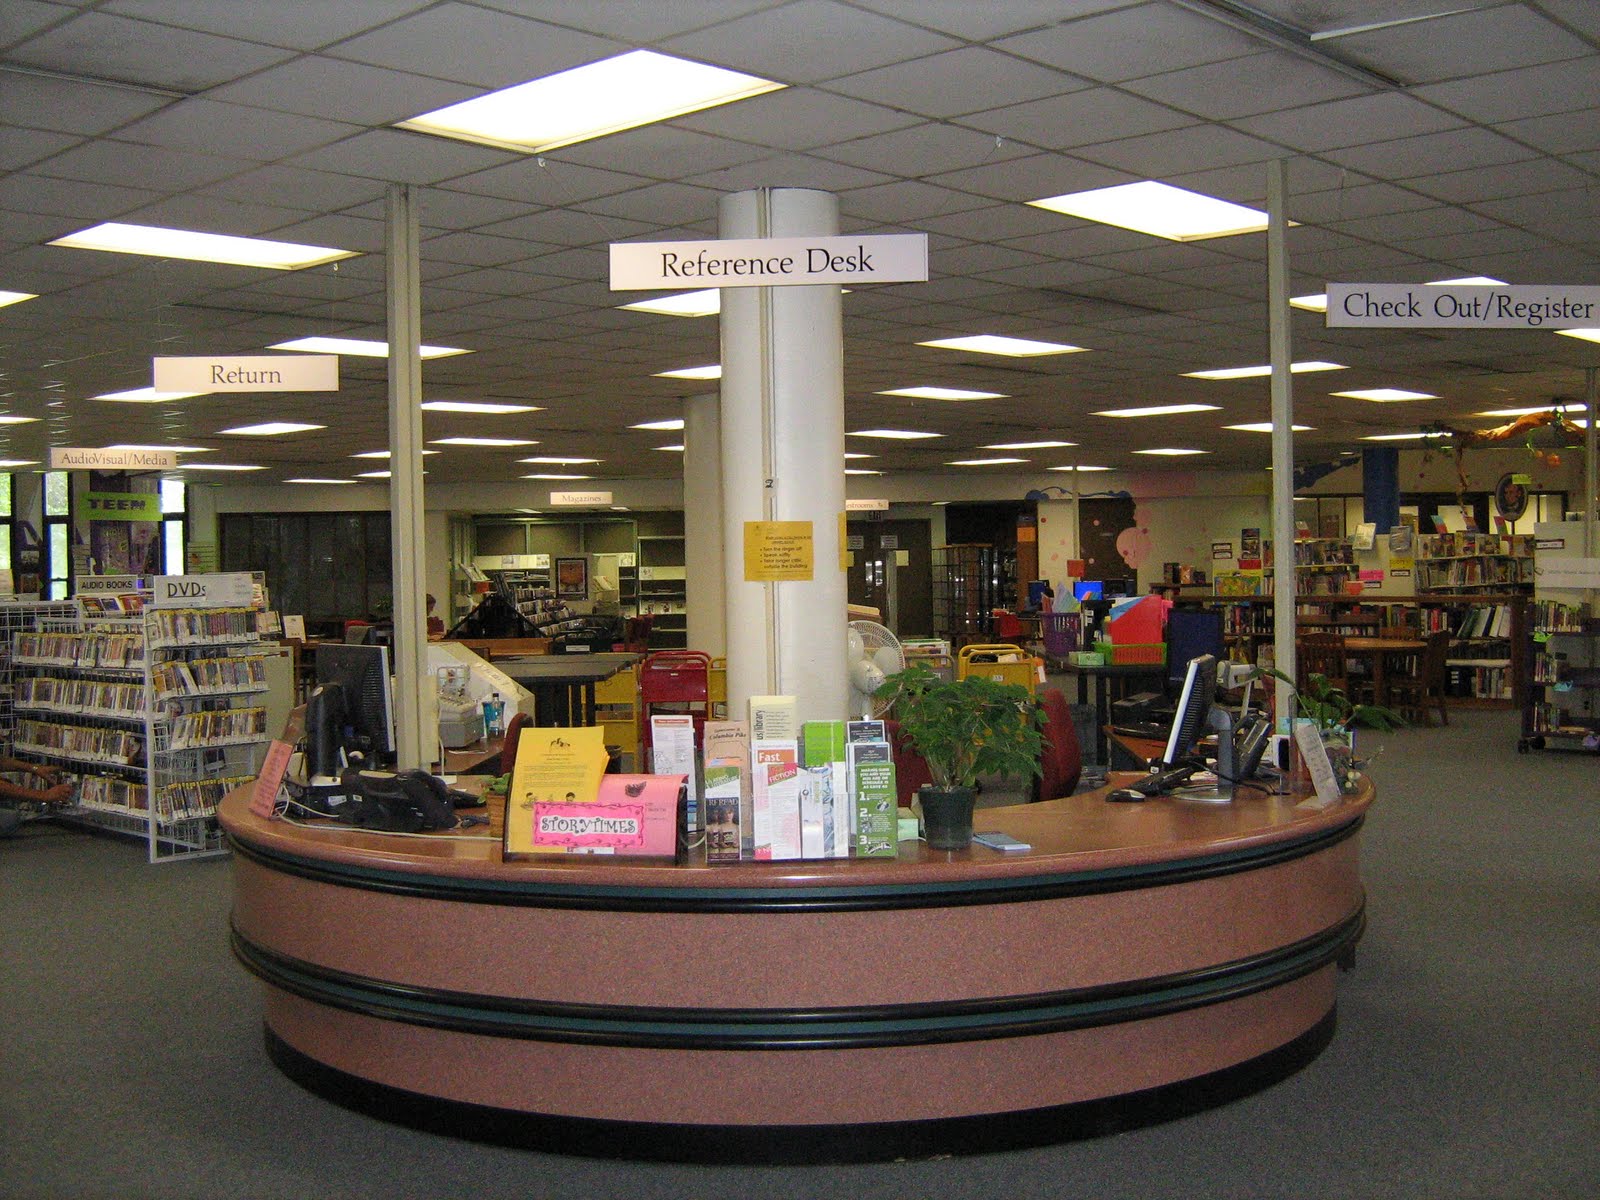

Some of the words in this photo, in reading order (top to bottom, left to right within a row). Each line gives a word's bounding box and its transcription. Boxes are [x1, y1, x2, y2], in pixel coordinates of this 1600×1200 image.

[661, 249, 794, 278] Reference
[806, 245, 875, 274] Desk
[1343, 292, 1422, 318] Check
[1434, 291, 1595, 326] Out/Register
[210, 364, 282, 384] Return
[61, 452, 168, 466] AudioVisual/Media
[561, 494, 603, 505] Magazines
[81, 580, 104, 590] AUDIO
[106, 580, 133, 589] BOOKS
[167, 581, 207, 597] DVDs
[758, 751, 781, 762] Fast
[768, 769, 796, 783] FICTION
[859, 791, 870, 801] 1.
[859, 807, 872, 817] 2.
[541, 816, 636, 834] STORYTIMES
[859, 835, 872, 845] 3.
